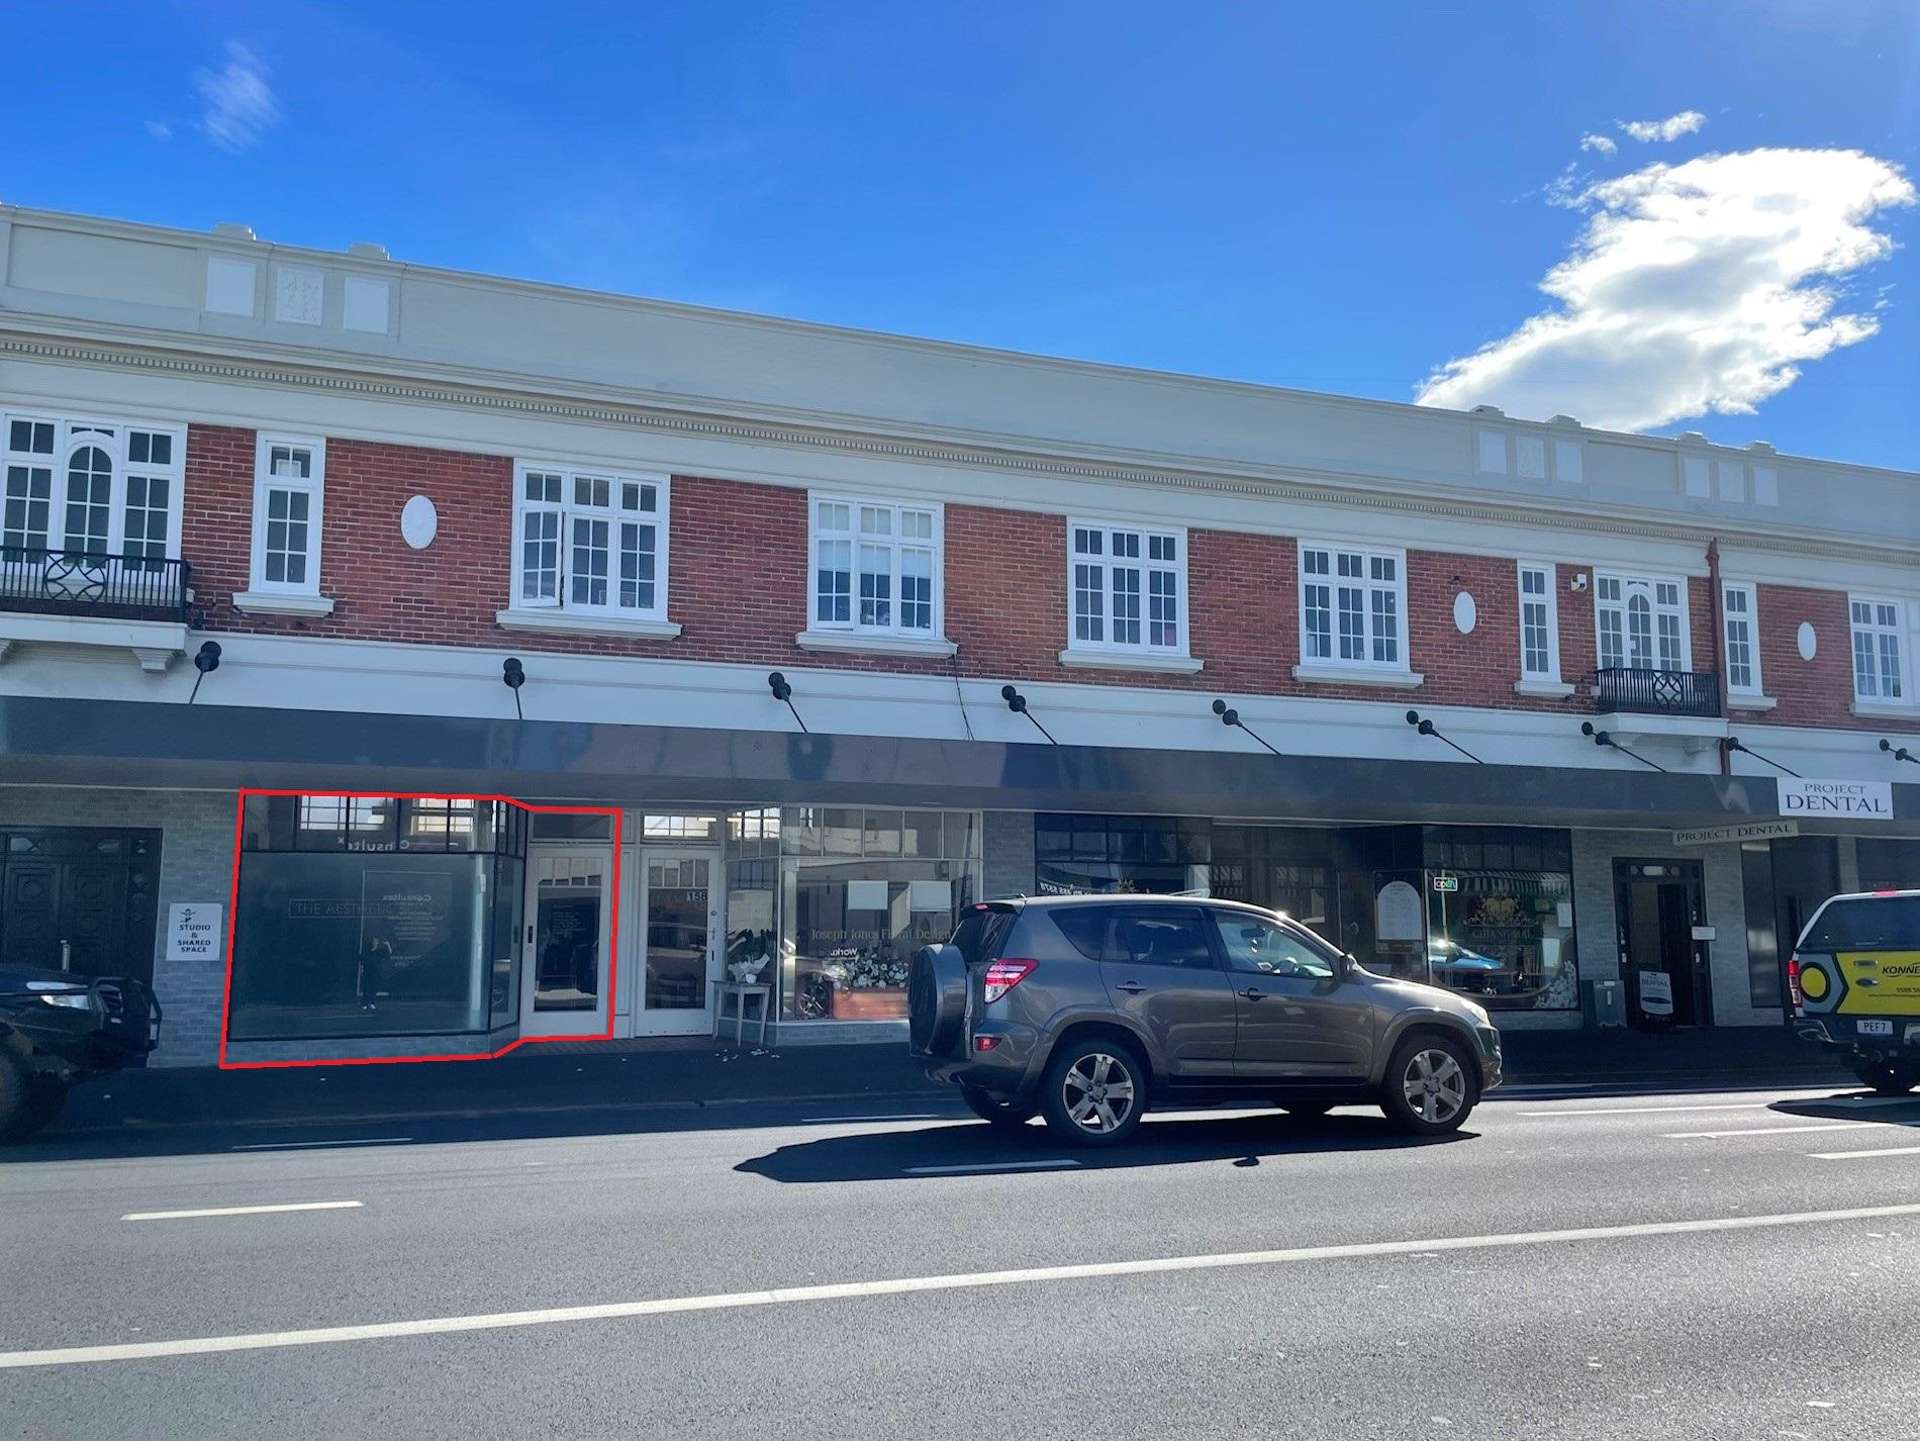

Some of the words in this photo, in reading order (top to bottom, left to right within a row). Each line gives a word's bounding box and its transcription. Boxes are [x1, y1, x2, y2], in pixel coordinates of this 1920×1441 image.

[1804, 783, 1867, 794] PROJECT
[1786, 794, 1888, 813] DENTAL
[1676, 830, 1730, 842] PROJECT
[1737, 823, 1792, 837] DENTAL
[294, 903, 321, 914] THE
